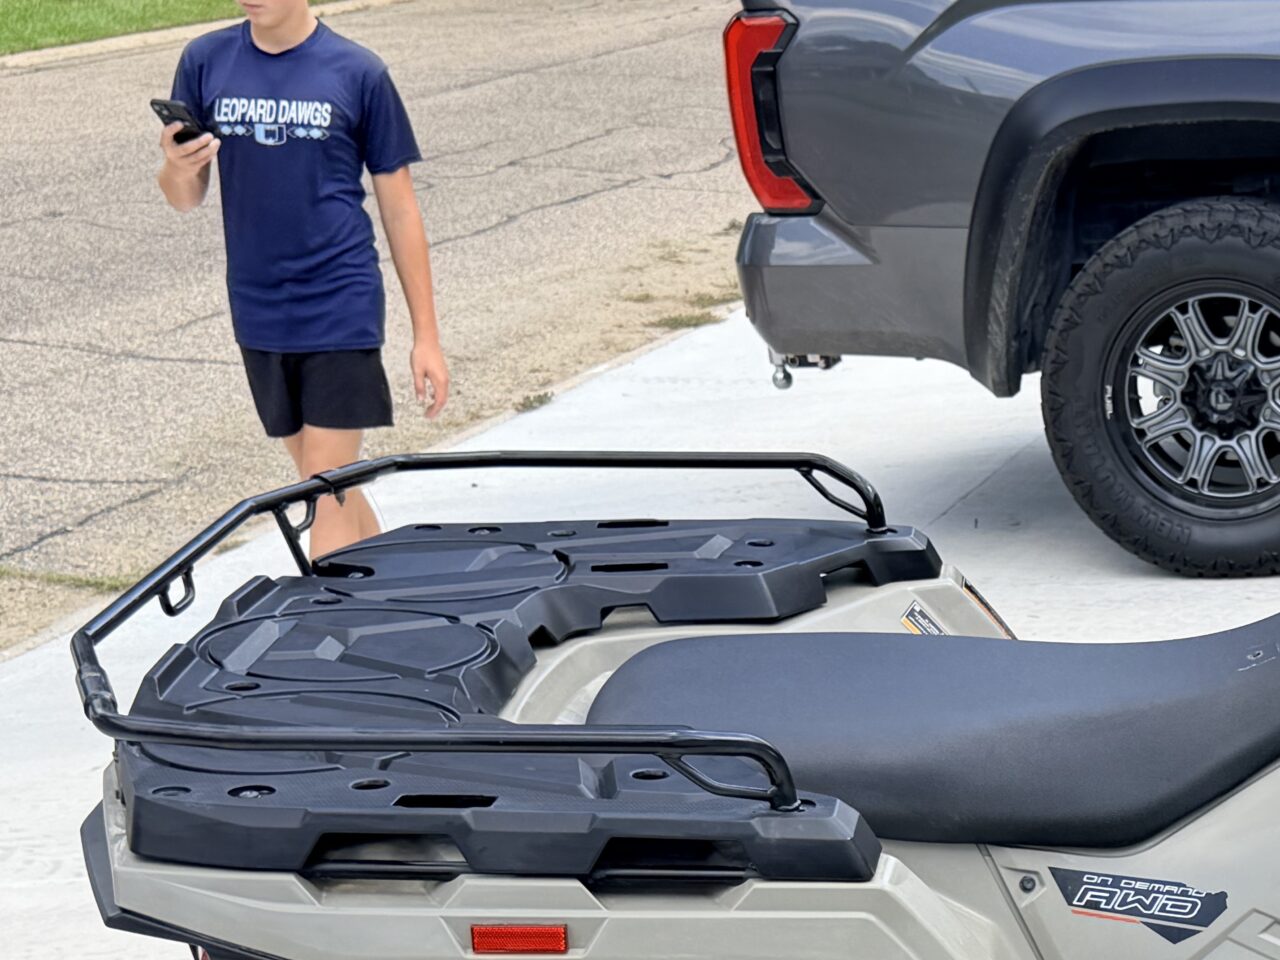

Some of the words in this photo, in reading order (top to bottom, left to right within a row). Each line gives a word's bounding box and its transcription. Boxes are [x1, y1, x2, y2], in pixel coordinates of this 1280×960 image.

[214, 98, 276, 123] LEOPARD
[278, 100, 332, 127] DAWGS
[1083, 874, 1113, 885] ON
[1072, 885, 1202, 919] AWD
